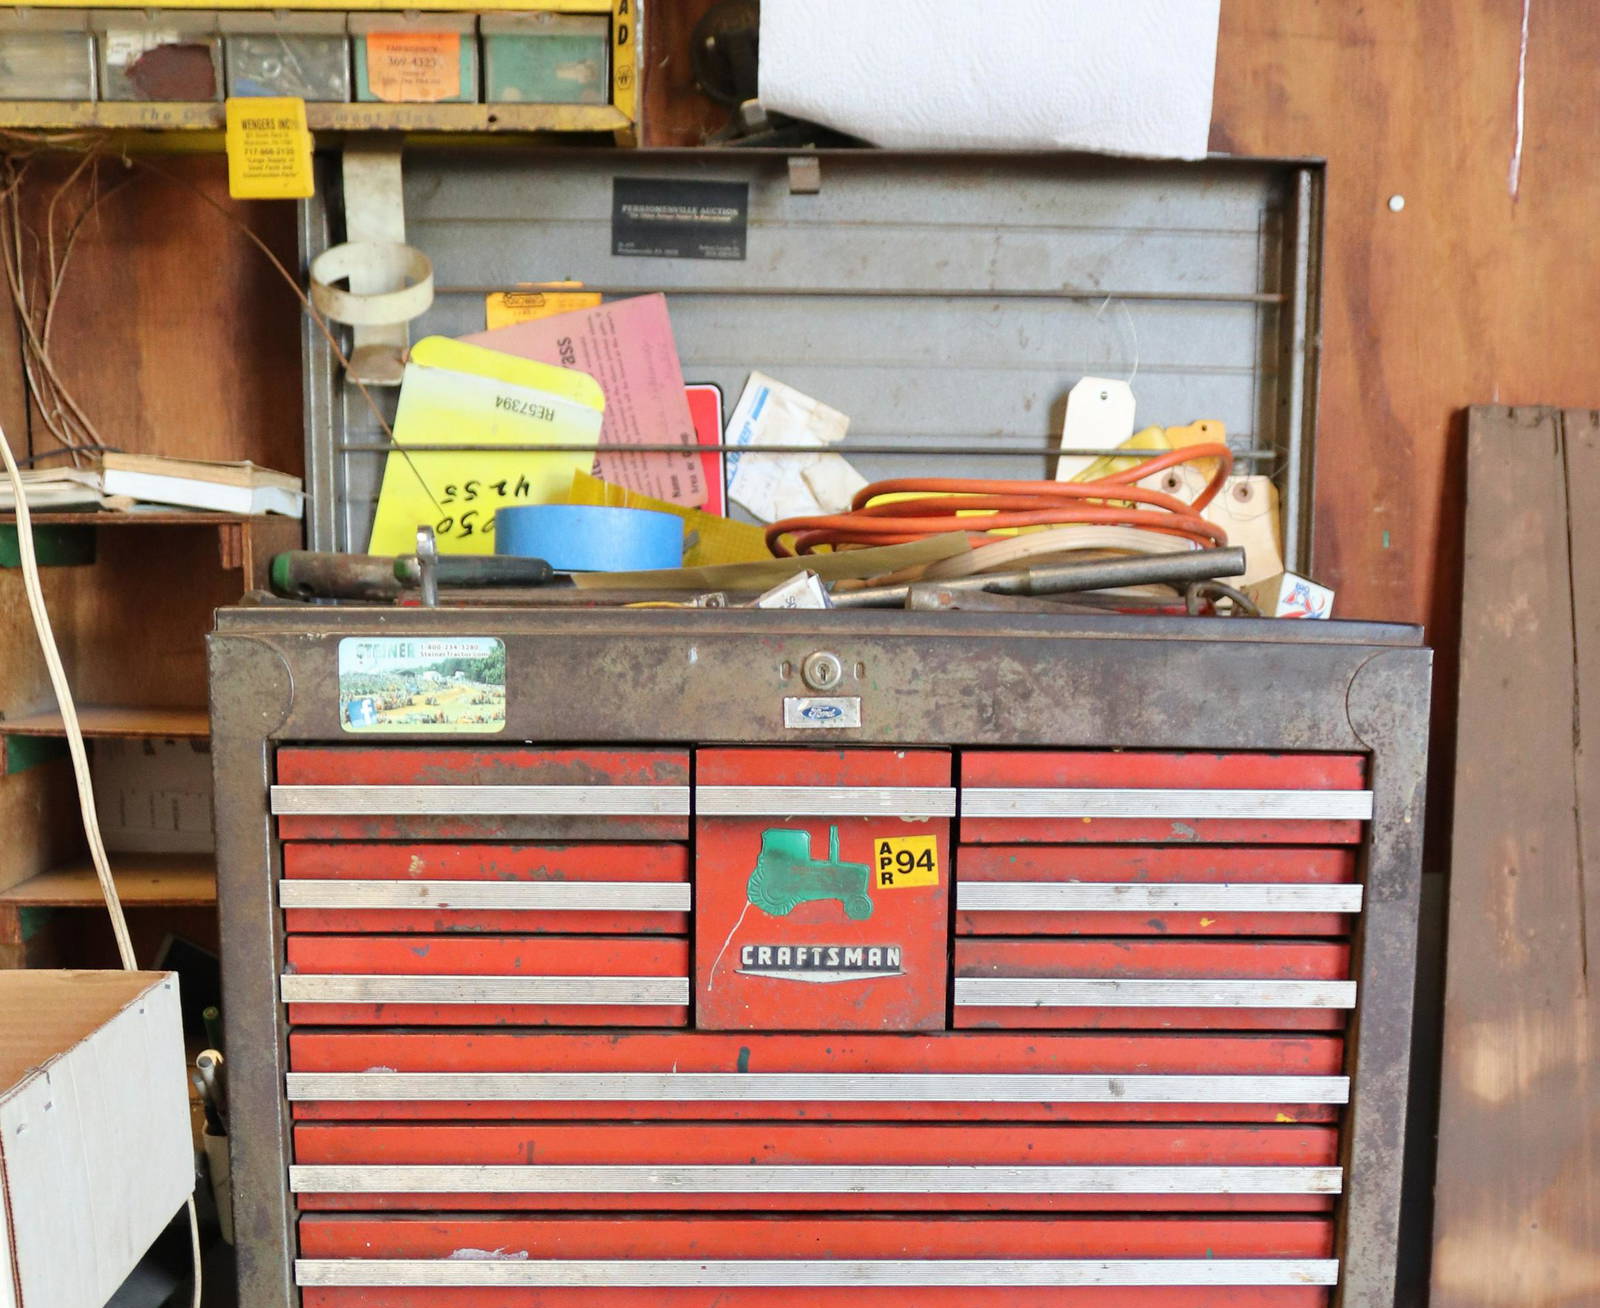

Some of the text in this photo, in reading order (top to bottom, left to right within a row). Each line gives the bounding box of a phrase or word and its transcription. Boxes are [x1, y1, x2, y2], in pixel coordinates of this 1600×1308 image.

[495, 395, 556, 422] RE57394
[441, 474, 530, 504] 4255
[879, 841, 936, 886] APR 94
[741, 946, 900, 967] CRAFTSMAN
